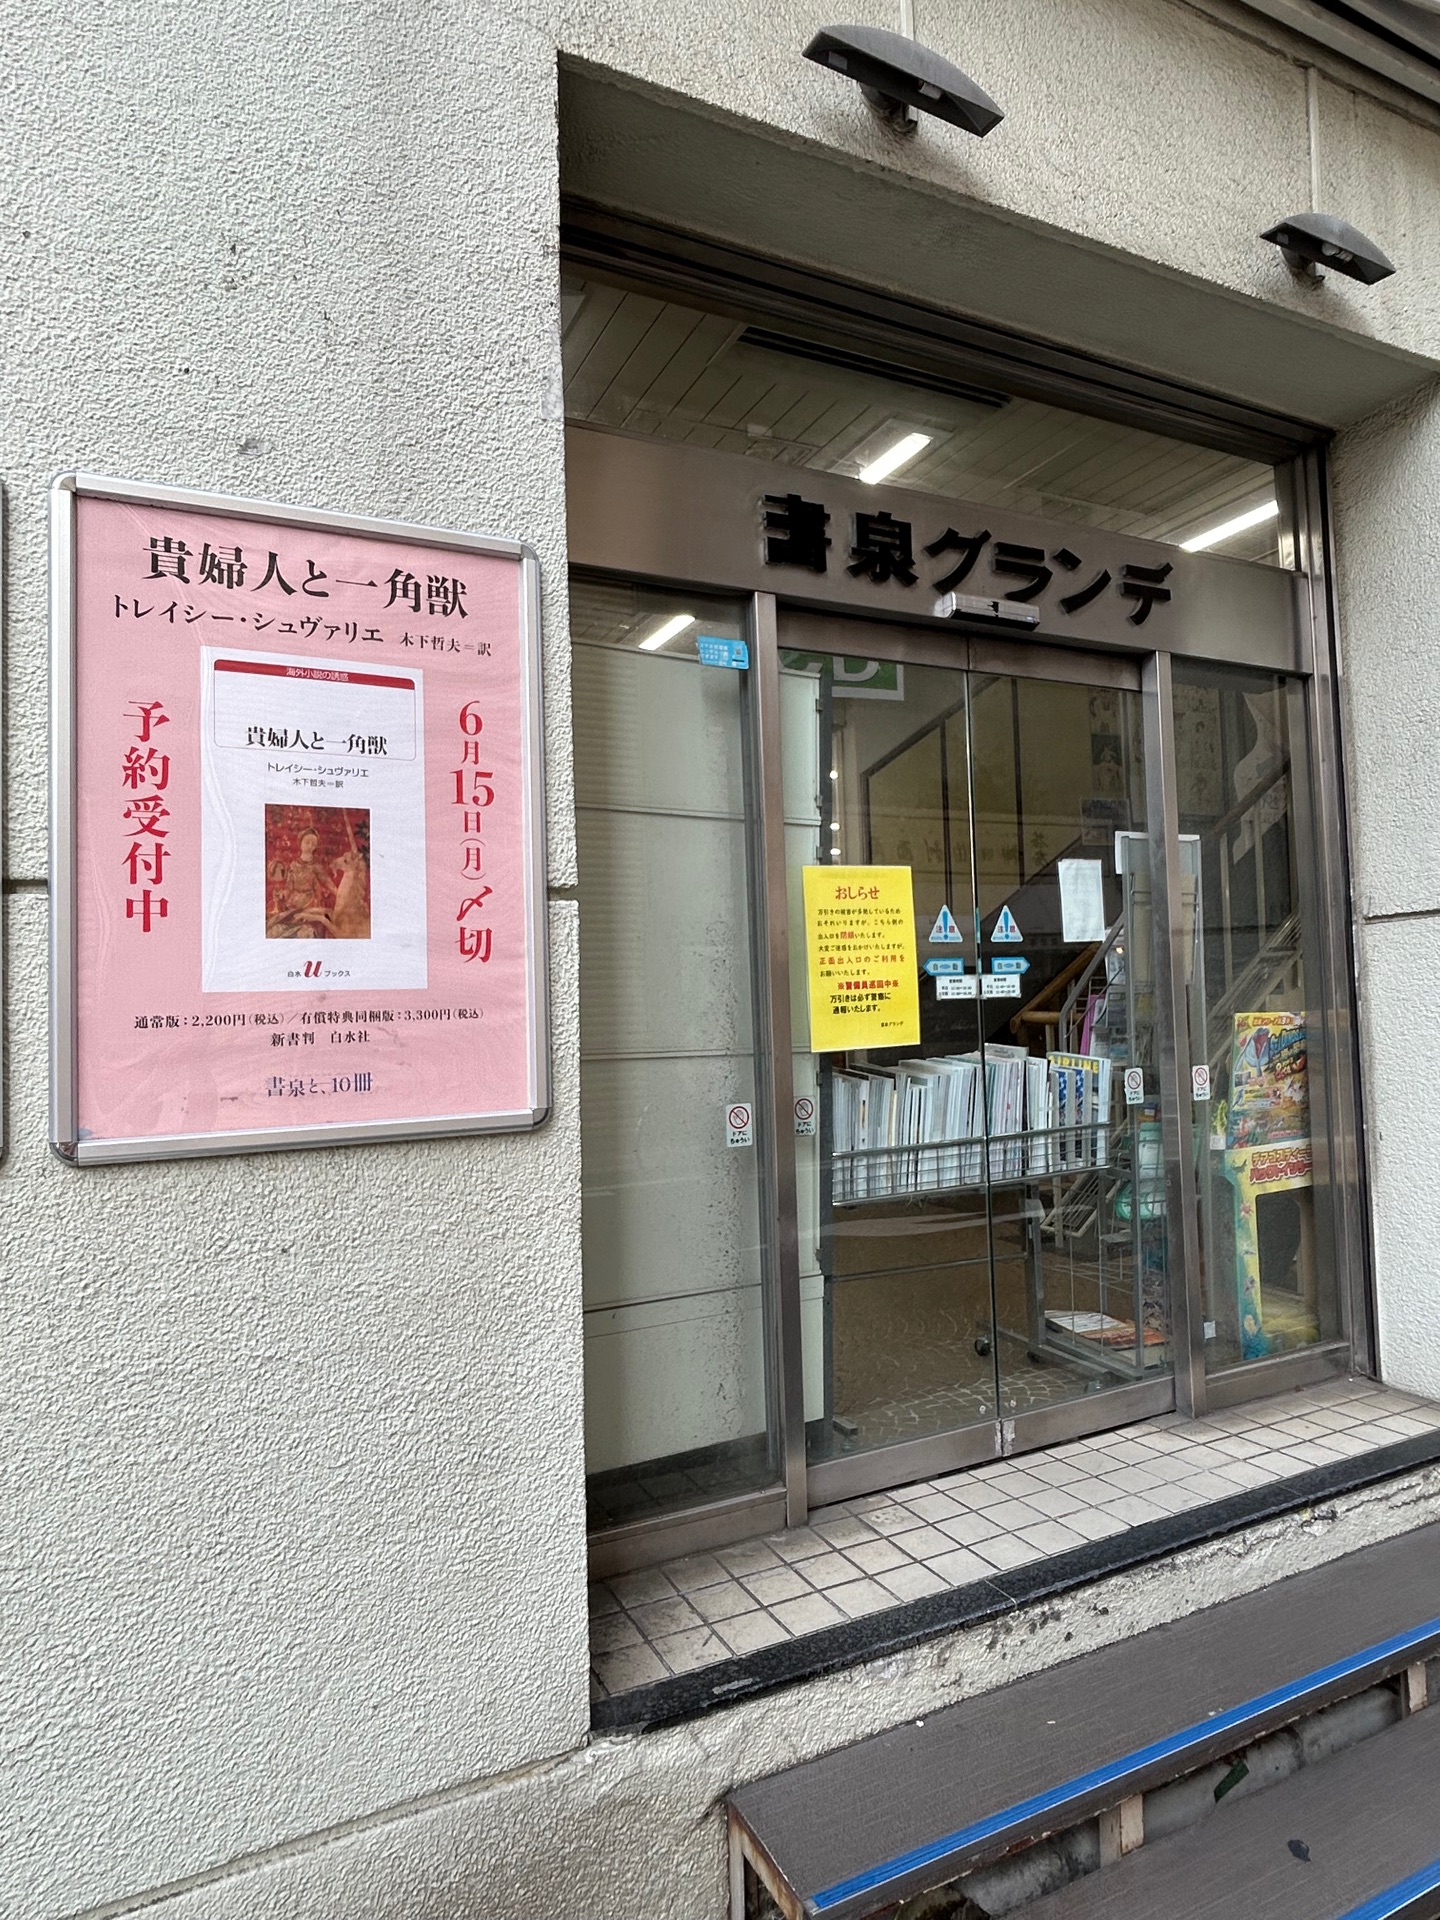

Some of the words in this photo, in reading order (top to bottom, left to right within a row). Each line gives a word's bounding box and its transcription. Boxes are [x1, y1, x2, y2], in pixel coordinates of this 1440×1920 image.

[142, 536, 469, 619] 貴婦人と一角獣
[760, 494, 1173, 625] 書泉グランデ
[114, 595, 384, 644] トレイシー・シュヴァリエ
[245, 726, 388, 756] 貴婦人と一角獣
[121, 701, 172, 933] 予約受付中
[835, 886, 880, 900] おしらせ
[819, 954, 905, 965] 正面出入口のご利用を
[270, 1031, 316, 1047] 新書判
[330, 1030, 370, 1044] 白水社
